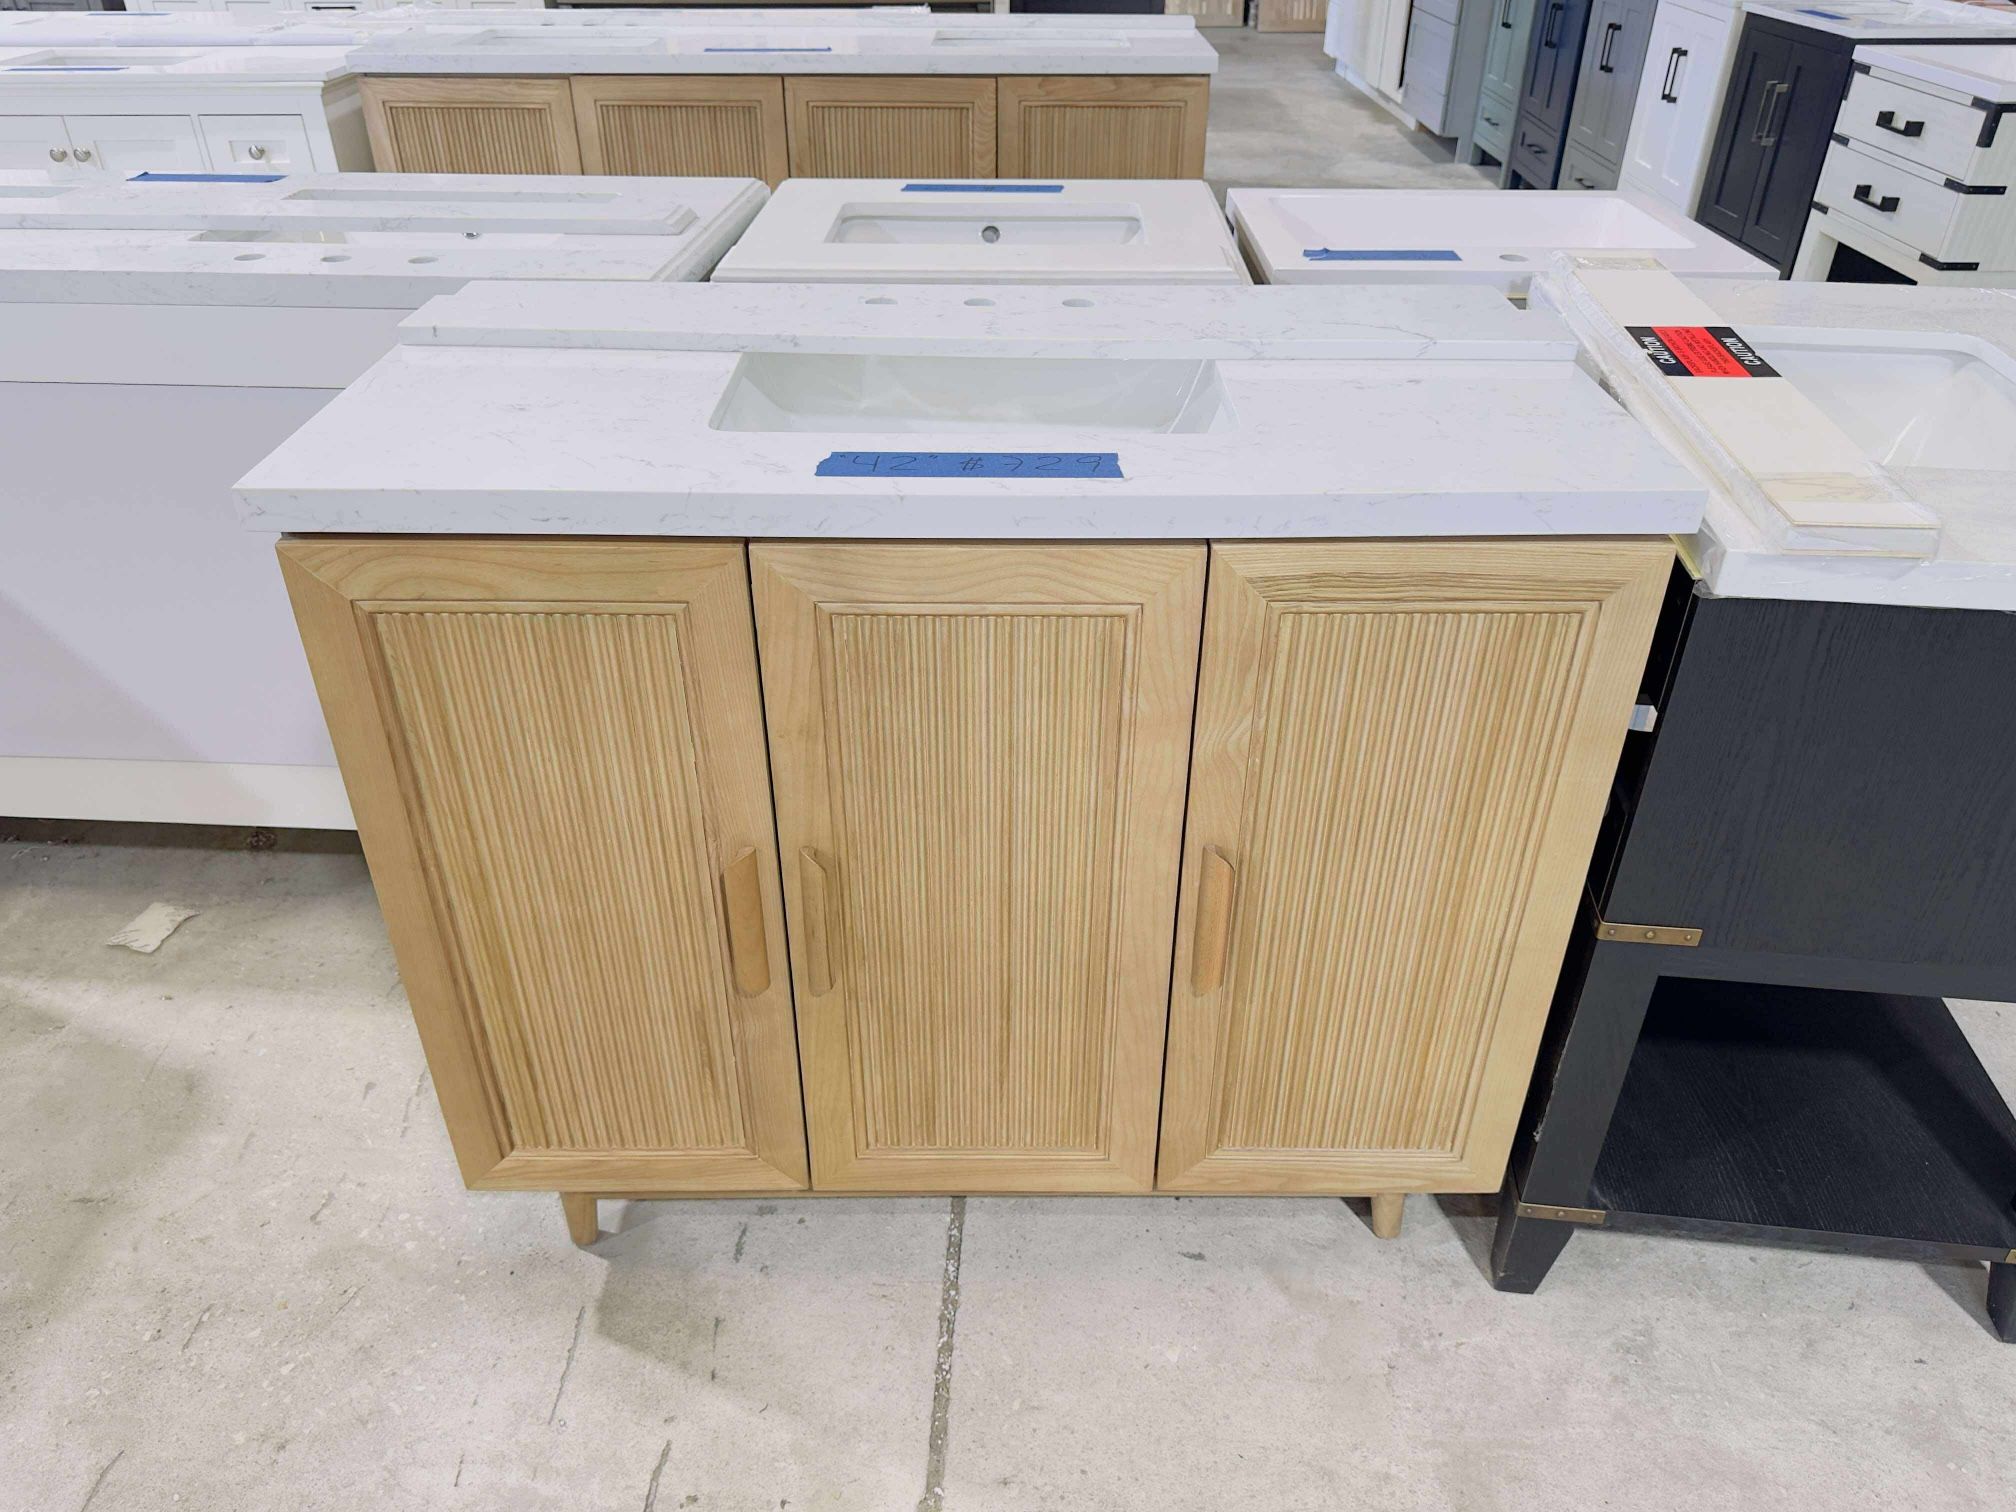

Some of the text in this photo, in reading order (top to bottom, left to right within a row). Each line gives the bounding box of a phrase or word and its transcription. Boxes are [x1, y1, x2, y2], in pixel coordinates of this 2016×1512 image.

[1640, 336, 1676, 364] CAUTION
[1721, 338, 1761, 366] CAUTION
[959, 455, 1102, 473] #729
